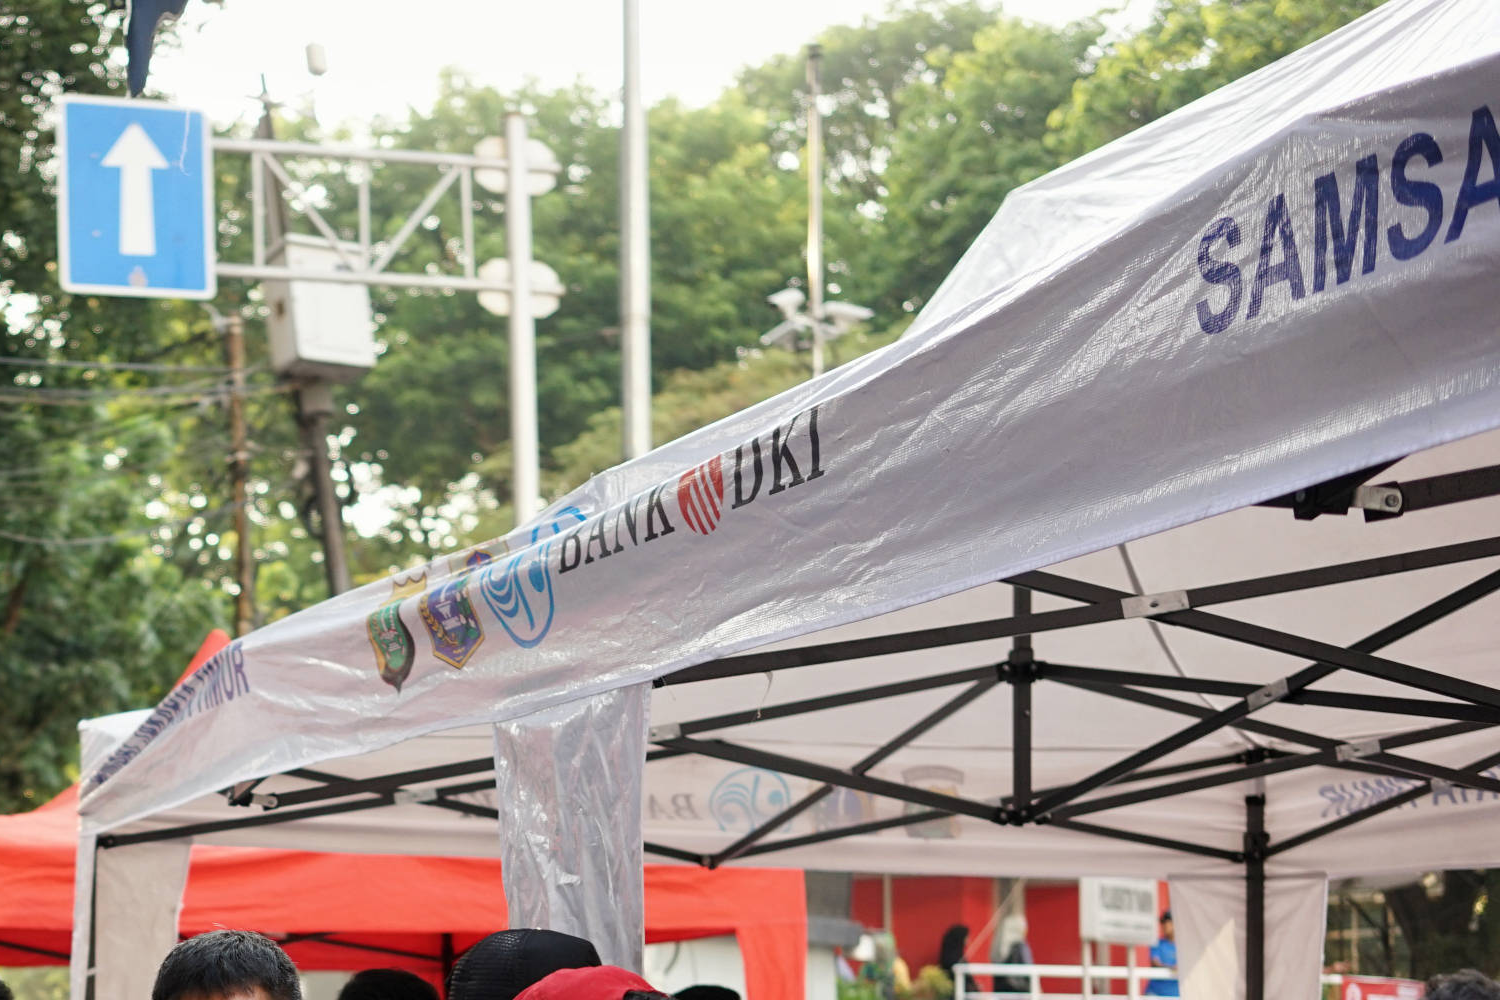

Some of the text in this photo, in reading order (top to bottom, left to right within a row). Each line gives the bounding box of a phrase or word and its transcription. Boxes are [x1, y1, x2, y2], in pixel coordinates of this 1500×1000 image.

[1195, 105, 1500, 334] SAMSA
[559, 402, 825, 575] BANK DKI
